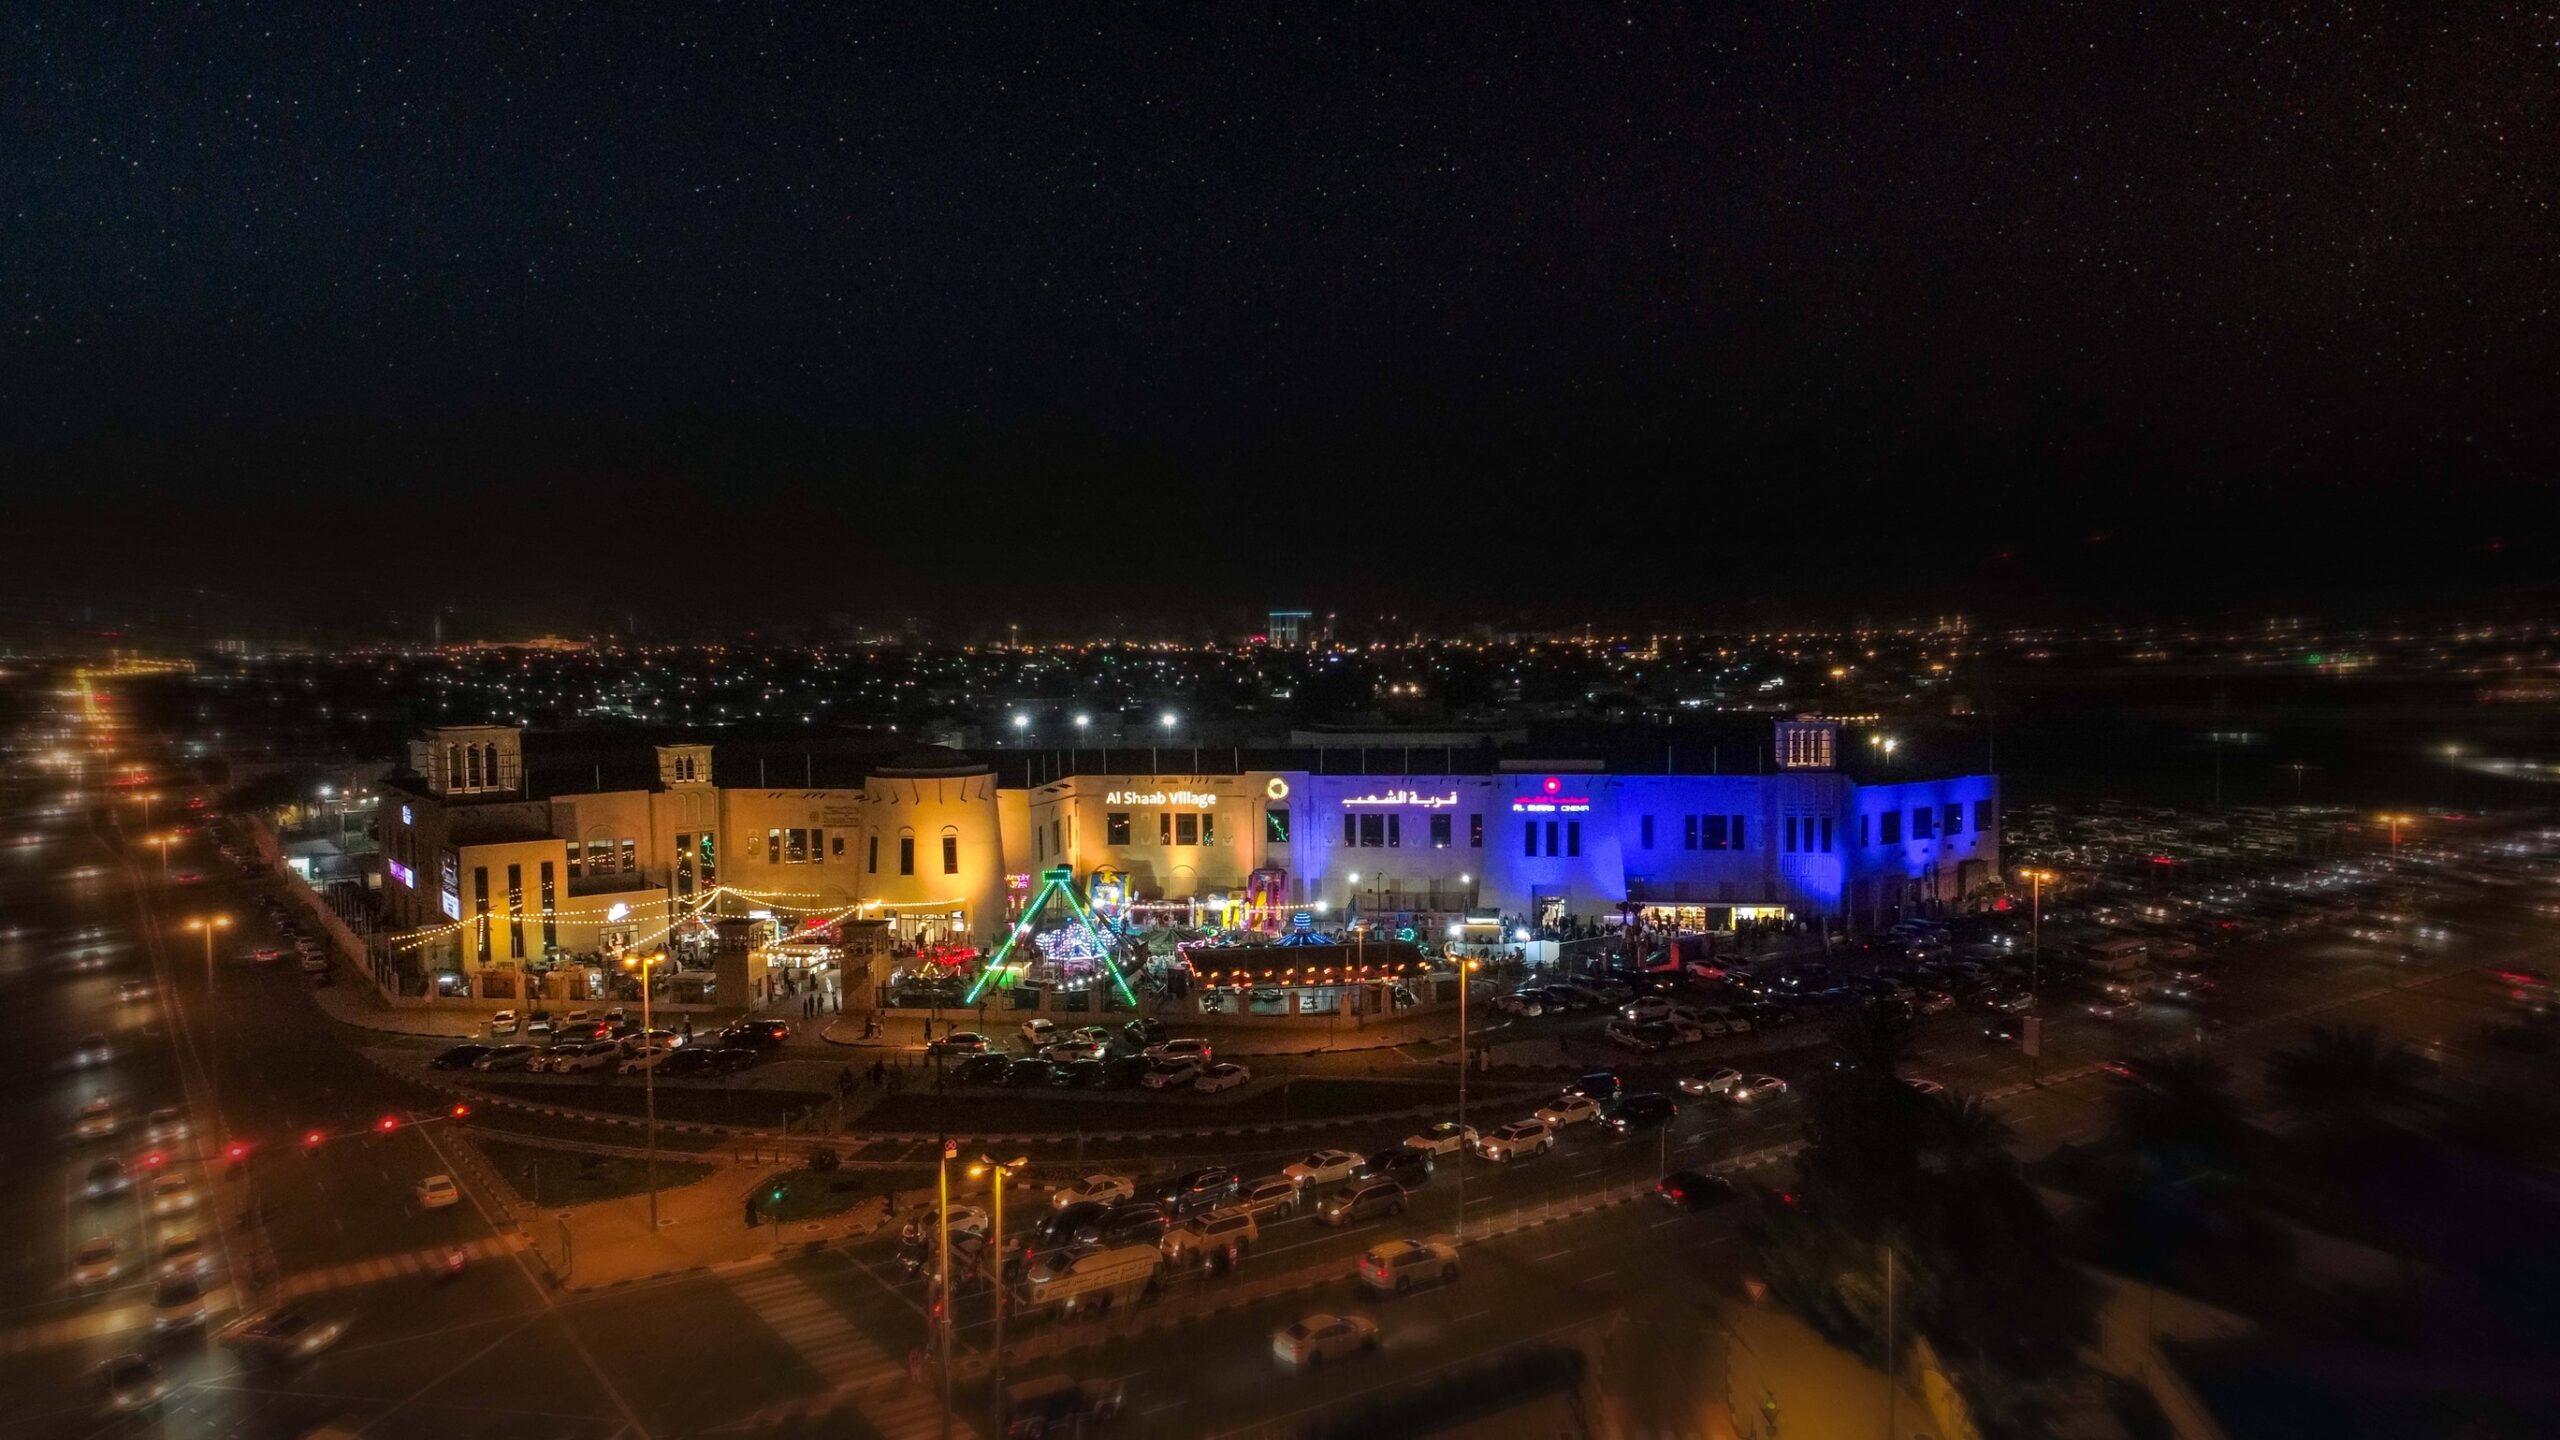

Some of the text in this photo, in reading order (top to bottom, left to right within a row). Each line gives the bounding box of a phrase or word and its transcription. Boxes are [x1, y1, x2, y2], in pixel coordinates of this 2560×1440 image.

[1106, 791, 1217, 809] Al Shaab Village
[1341, 789, 1458, 808] قرية الشعب
